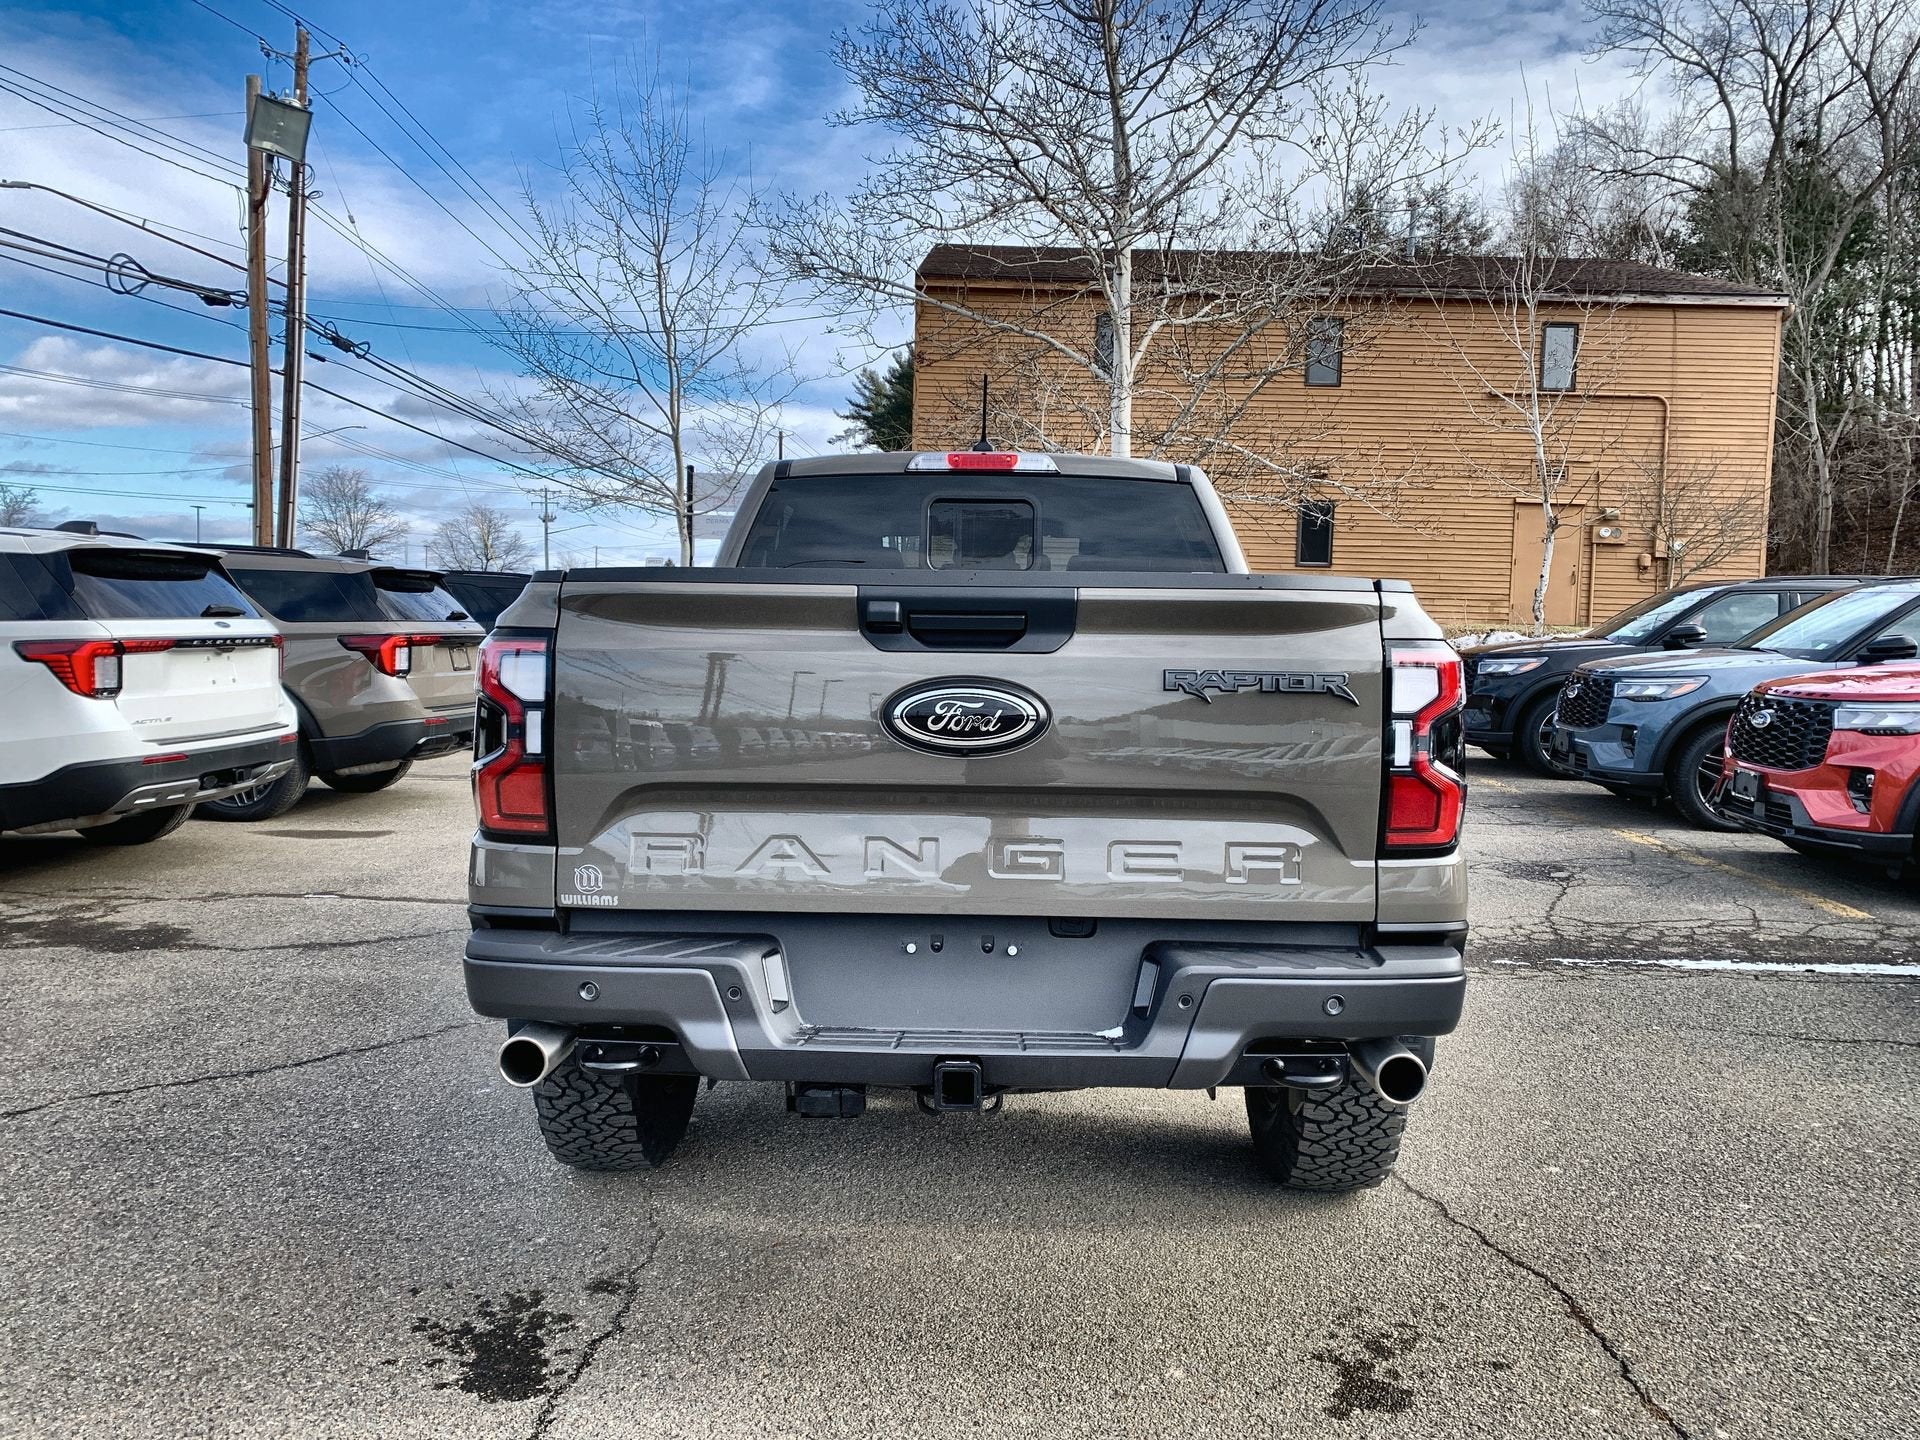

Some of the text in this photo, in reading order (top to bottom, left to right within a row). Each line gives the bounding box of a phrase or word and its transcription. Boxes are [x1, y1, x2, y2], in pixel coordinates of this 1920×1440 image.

[1163, 669, 1360, 706] RAPTOR
[927, 699, 1004, 732] Ford
[629, 832, 1304, 886] RANGER
[560, 894, 619, 906] WILLIAMS
